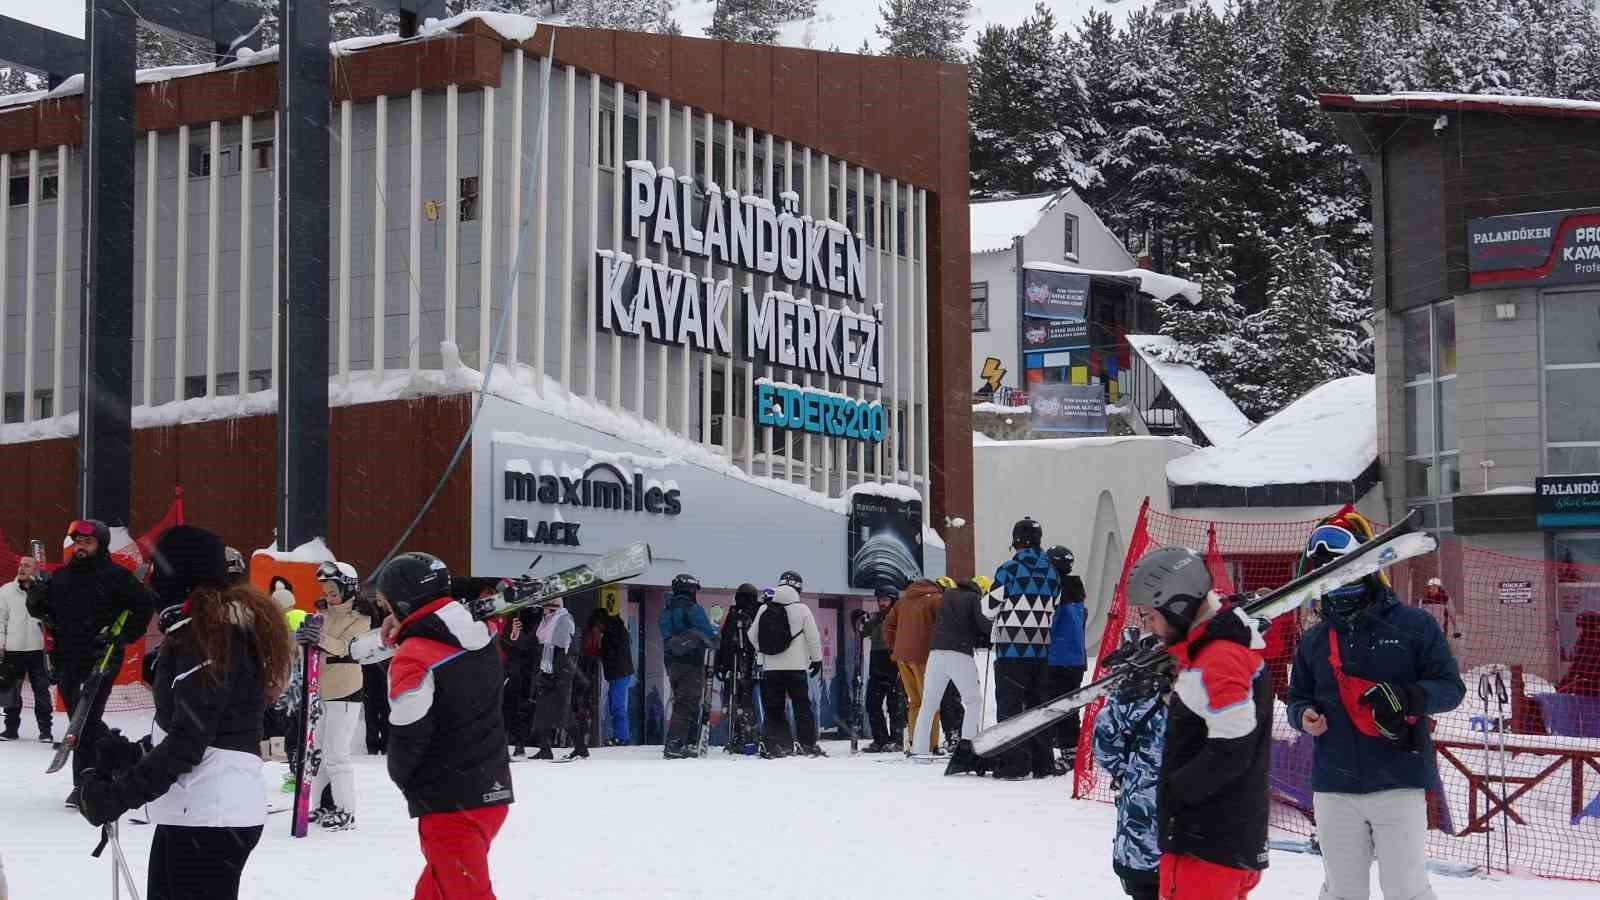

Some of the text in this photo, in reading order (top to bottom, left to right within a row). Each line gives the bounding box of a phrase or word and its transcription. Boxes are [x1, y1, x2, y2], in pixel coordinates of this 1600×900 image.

[629, 166, 866, 302] PALANDÖKEN
[1473, 227, 1551, 244] PALANDÖKEN
[597, 251, 884, 386] KAYAK MERKEZİ
[756, 383, 886, 442] EJDER3200
[504, 463, 681, 515] maximiles
[504, 517, 580, 546] BLACK
